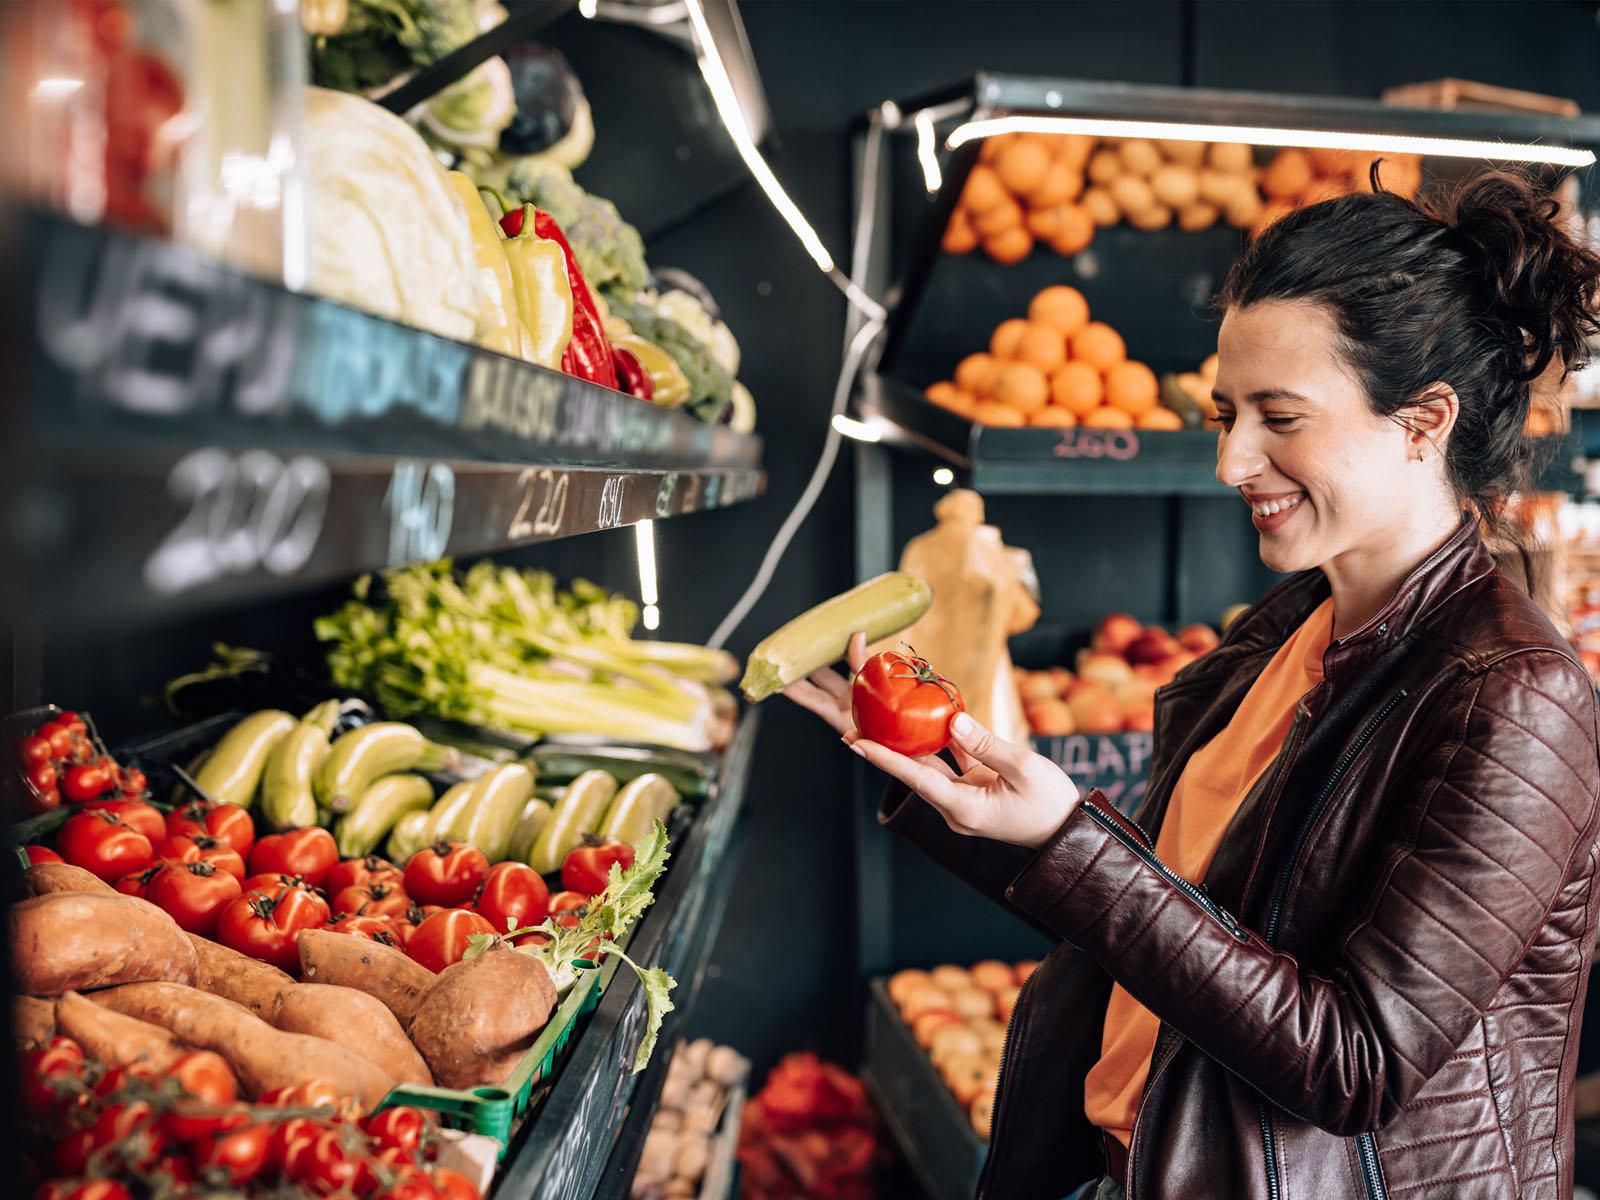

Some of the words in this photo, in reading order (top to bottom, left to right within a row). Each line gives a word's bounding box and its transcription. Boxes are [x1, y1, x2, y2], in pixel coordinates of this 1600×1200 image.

[1053, 428, 1140, 461] 260
[507, 466, 570, 540] 220
[598, 476, 625, 529] 690
